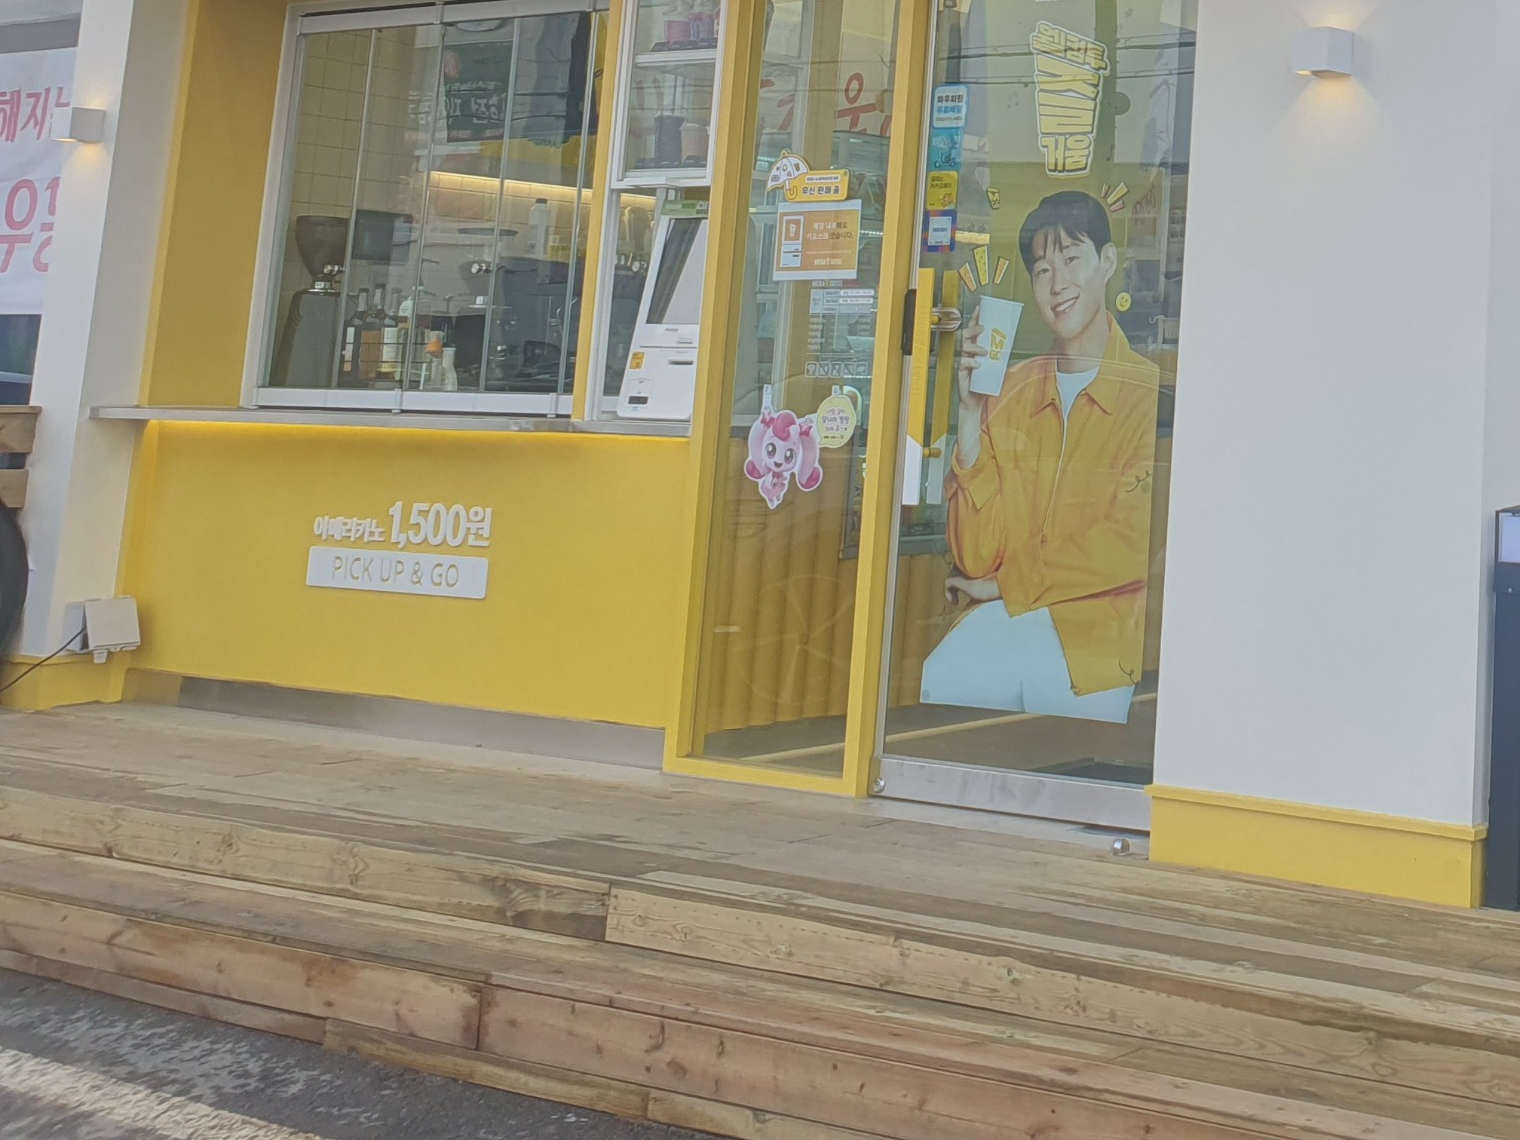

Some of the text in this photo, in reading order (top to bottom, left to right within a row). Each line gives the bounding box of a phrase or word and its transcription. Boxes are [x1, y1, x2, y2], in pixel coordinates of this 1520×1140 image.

[801, 186, 815, 195] 우산
[817, 185, 832, 196] 판매
[312, 500, 493, 549] 아메리카노 1,500원
[332, 556, 459, 588] PICK UP & GO
